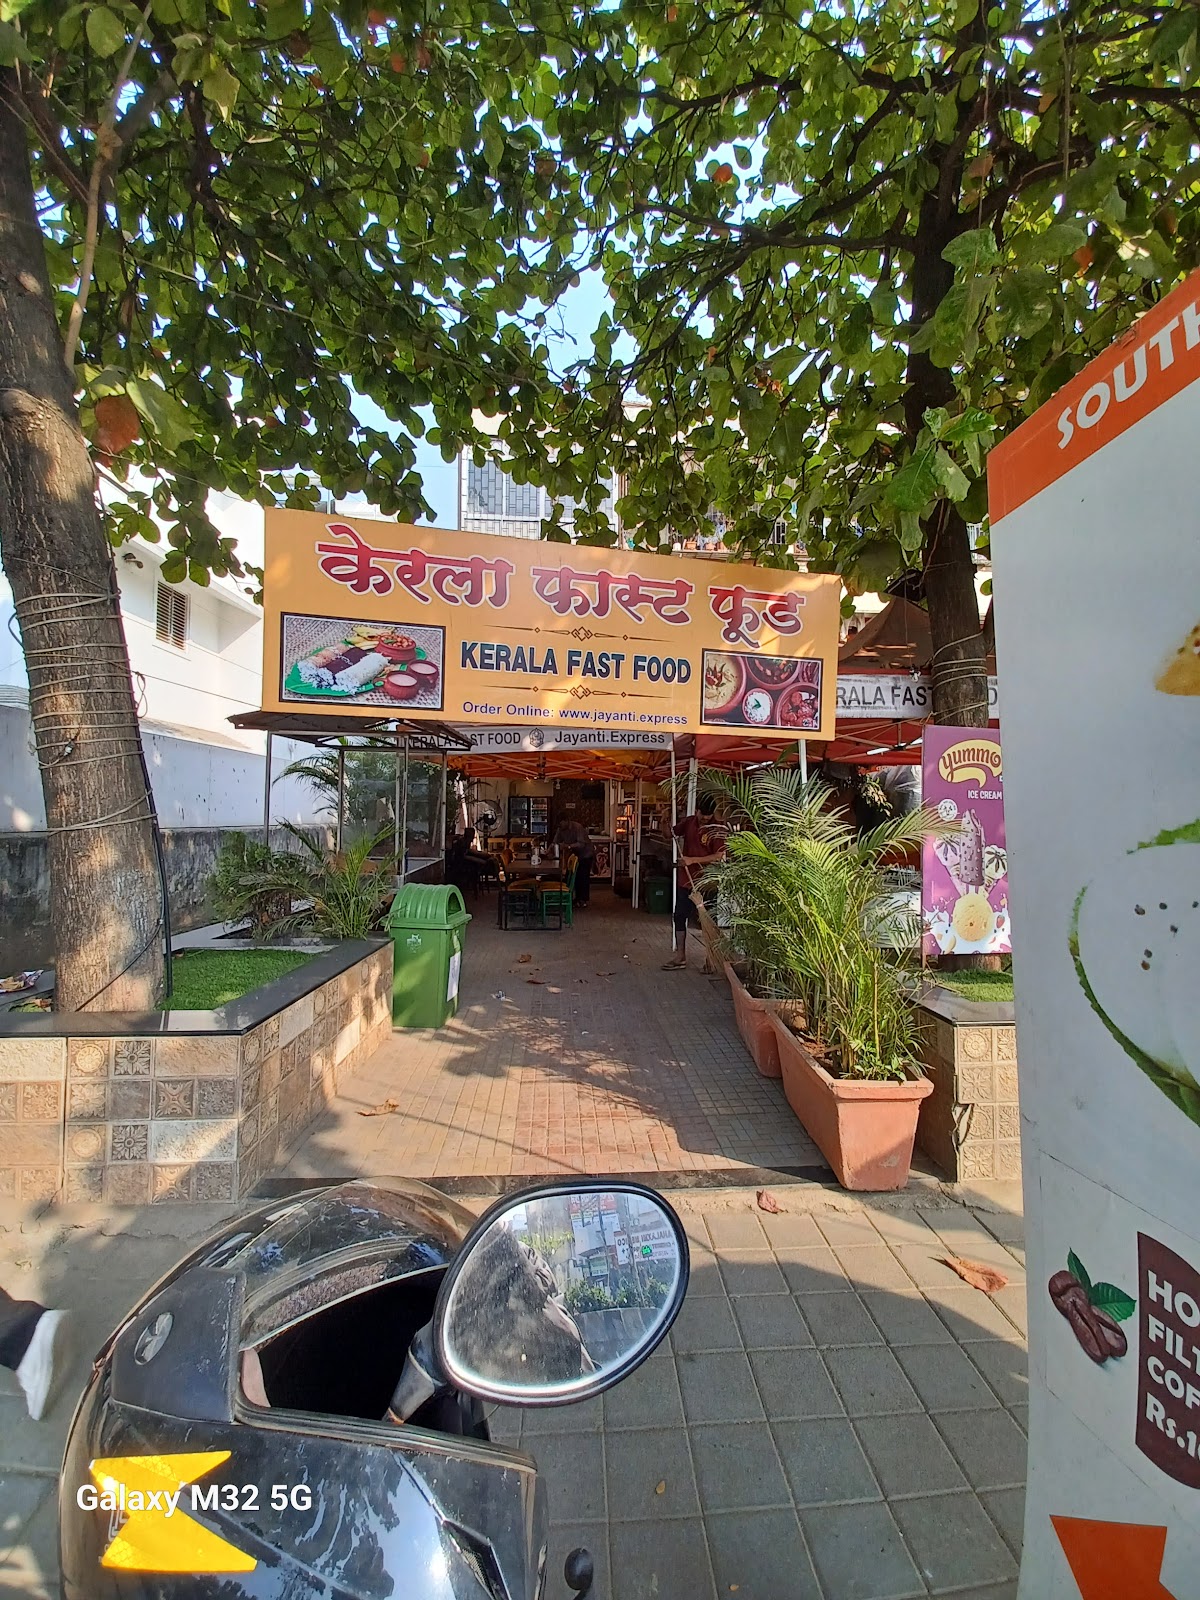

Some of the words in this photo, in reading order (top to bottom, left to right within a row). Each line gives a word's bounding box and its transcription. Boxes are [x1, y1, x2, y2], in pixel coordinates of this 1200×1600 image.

[316, 523, 515, 608] केरला
[531, 567, 694, 624] फास्ट
[709, 586, 806, 648] फूड
[461, 641, 558, 675] KERALA
[567, 649, 625, 680] FAST
[633, 655, 691, 684] FOOD
[462, 701, 502, 715] Order
[506, 703, 554, 718] Online:
[559, 707, 688, 726] www.jayanti.express
[488, 732, 521, 745] FOOD
[555, 731, 665, 745] Jayanti.Express
[967, 789, 979, 799] ICE
[980, 790, 1002, 800] CREAM
